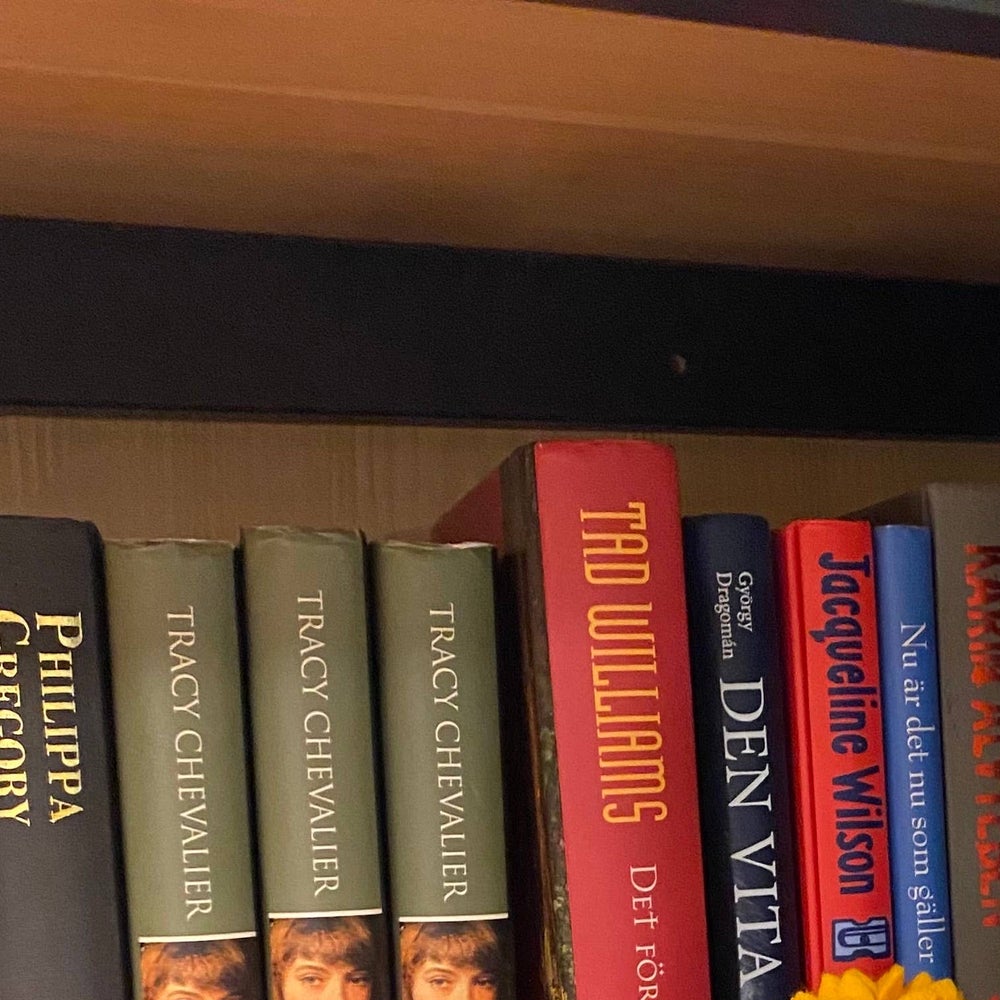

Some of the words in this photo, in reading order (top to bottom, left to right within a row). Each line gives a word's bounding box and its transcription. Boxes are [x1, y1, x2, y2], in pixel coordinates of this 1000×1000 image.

[580, 501, 651, 585] TAD
[297, 590, 329, 700] TRACY
[429, 602, 459, 711] TRACY
[714, 572, 737, 660] Dragomán
[735, 571, 753, 632] György
[809, 552, 883, 755] Jacqueline
[900, 622, 928, 668] Nu
[166, 605, 201, 719] TRACY
[587, 602, 668, 824] WILLIAMS
[904, 678, 928, 708] är
[35, 611, 84, 824] PHILIPPA
[719, 676, 773, 811] DEN
[907, 715, 935, 761] det
[175, 730, 213, 921] CHEVALIER
[304, 711, 340, 898] CHEVALIER
[435, 720, 469, 902] CHEVALIER
[831, 765, 884, 895] Wilson
[909, 769, 929, 808] nu
[912, 818, 930, 877] som
[730, 831, 783, 988] VITA
[907, 887, 946, 965] gäller
